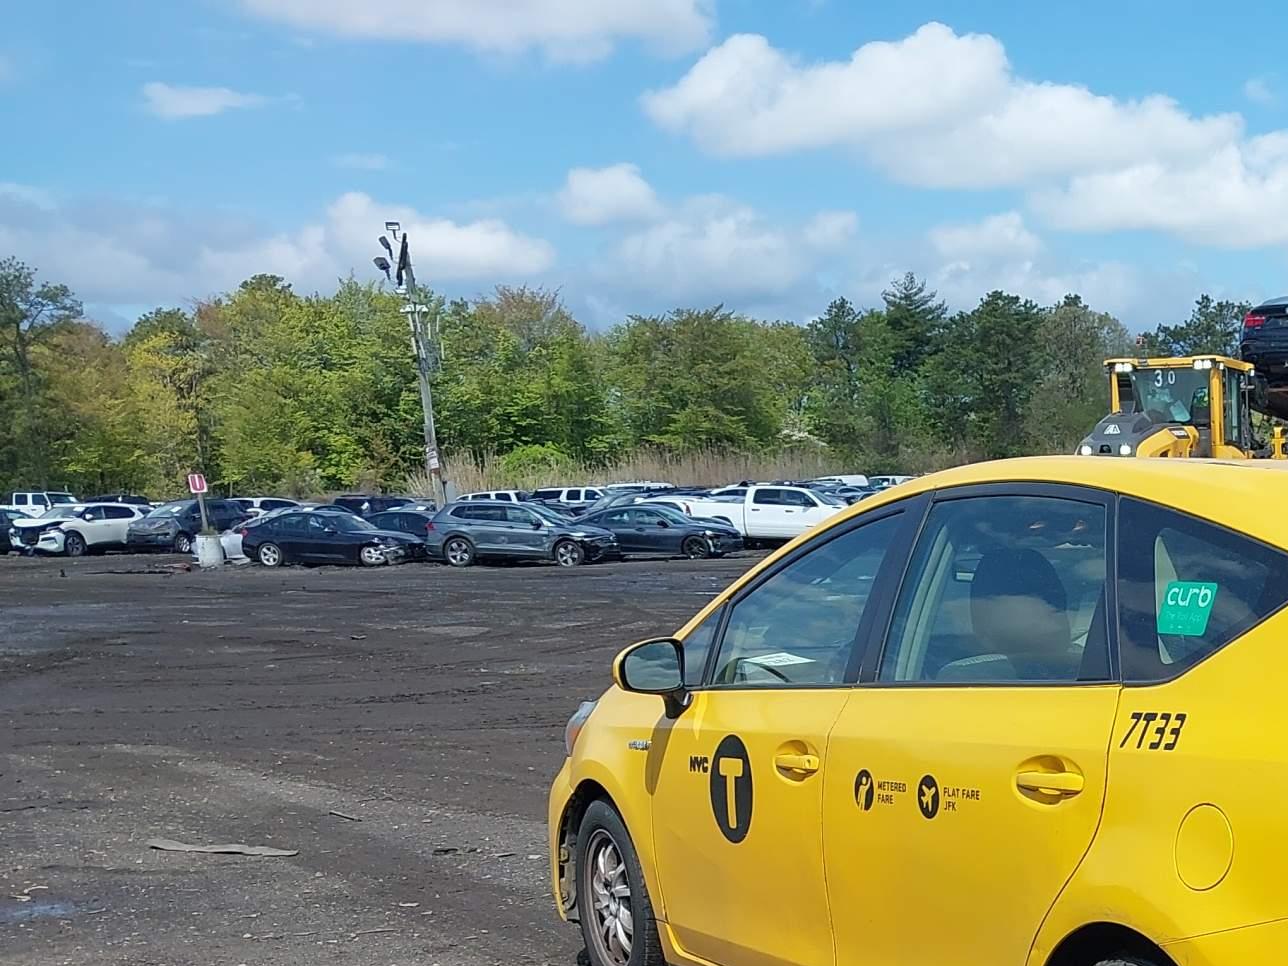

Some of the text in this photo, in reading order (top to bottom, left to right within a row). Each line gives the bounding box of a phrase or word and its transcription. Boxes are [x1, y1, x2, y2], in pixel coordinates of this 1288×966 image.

[1167, 585, 1212, 608] curb
[1119, 712, 1187, 750] 7T33
[689, 755, 709, 773] NYC
[719, 757, 743, 829] T
[877, 781, 907, 793] METERED
[943, 787, 980, 801] FLAT FARE
[877, 794, 894, 804] FARE
[943, 801, 957, 811] JFK
